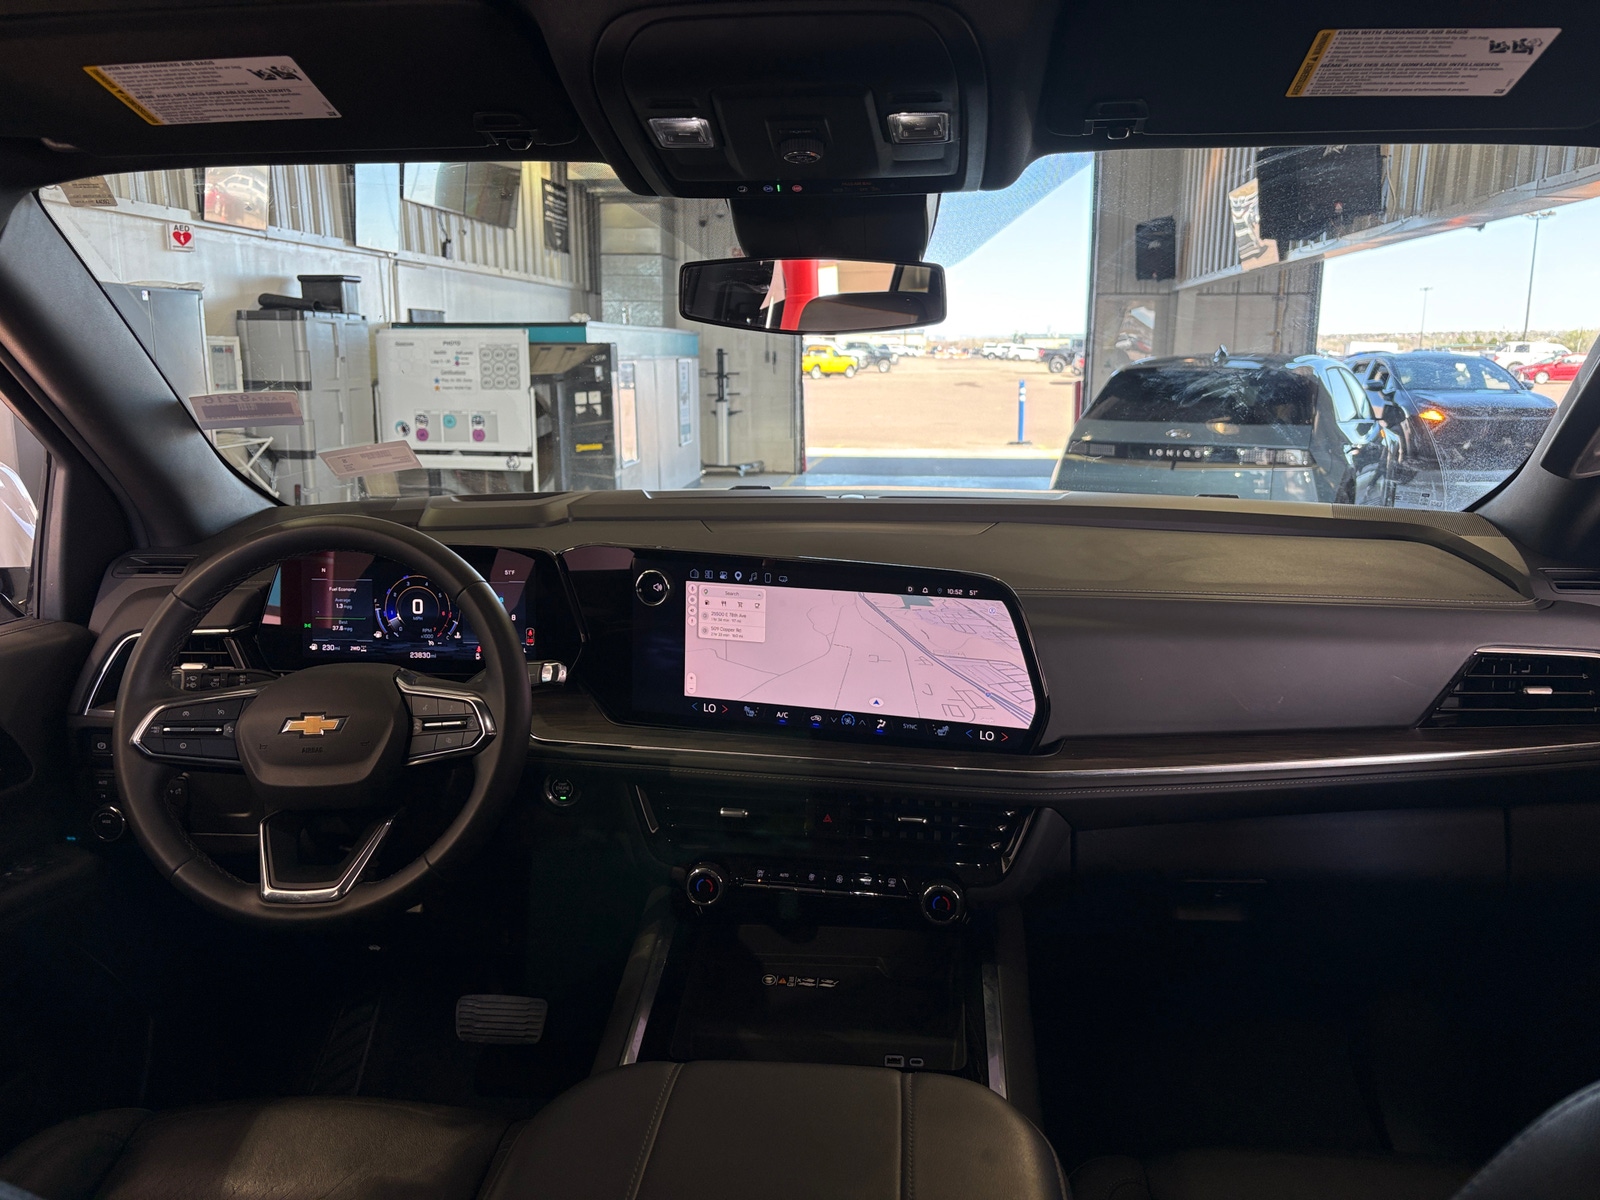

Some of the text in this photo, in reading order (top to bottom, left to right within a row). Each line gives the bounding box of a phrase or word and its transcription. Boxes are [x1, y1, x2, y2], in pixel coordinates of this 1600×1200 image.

[412, 598, 424, 615] 0
[703, 703, 717, 713] LO
[980, 730, 995, 741] LO
